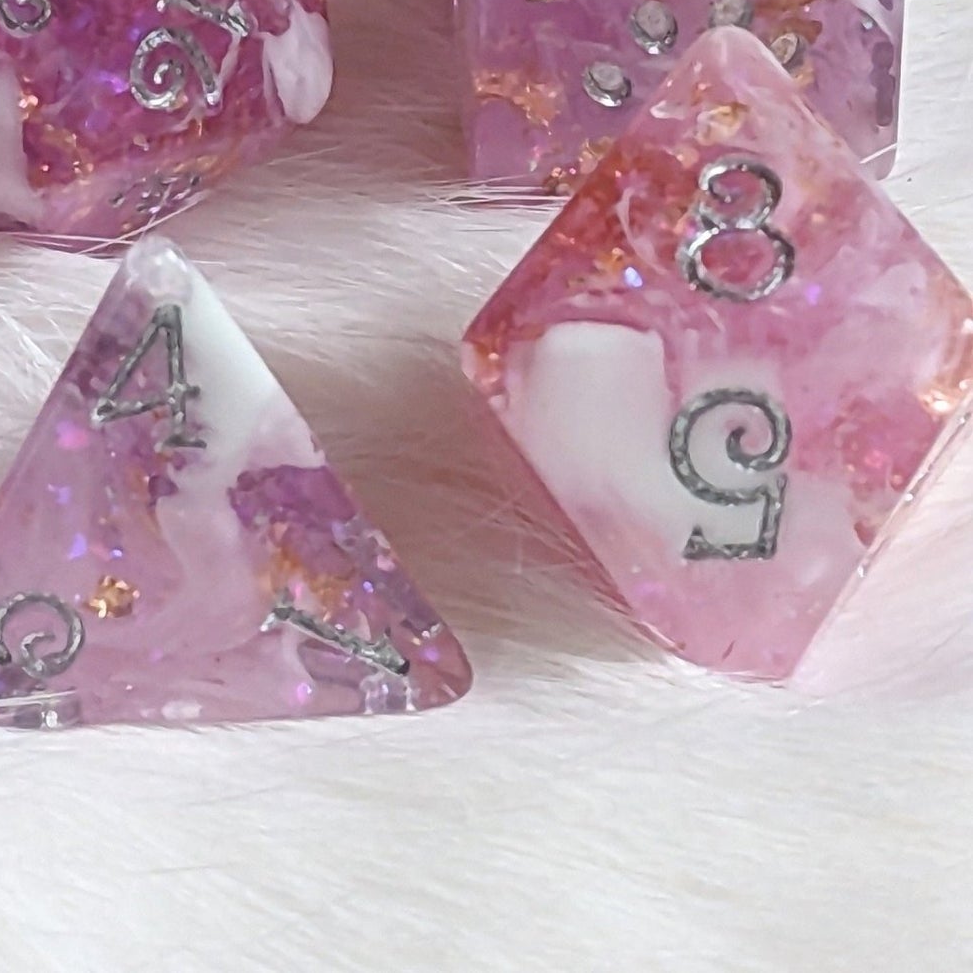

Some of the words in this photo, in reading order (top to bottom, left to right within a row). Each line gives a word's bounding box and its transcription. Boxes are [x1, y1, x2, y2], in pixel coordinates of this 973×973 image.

[676, 154, 796, 304] 8
[90, 303, 208, 451] 4
[670, 387, 793, 561] 5
